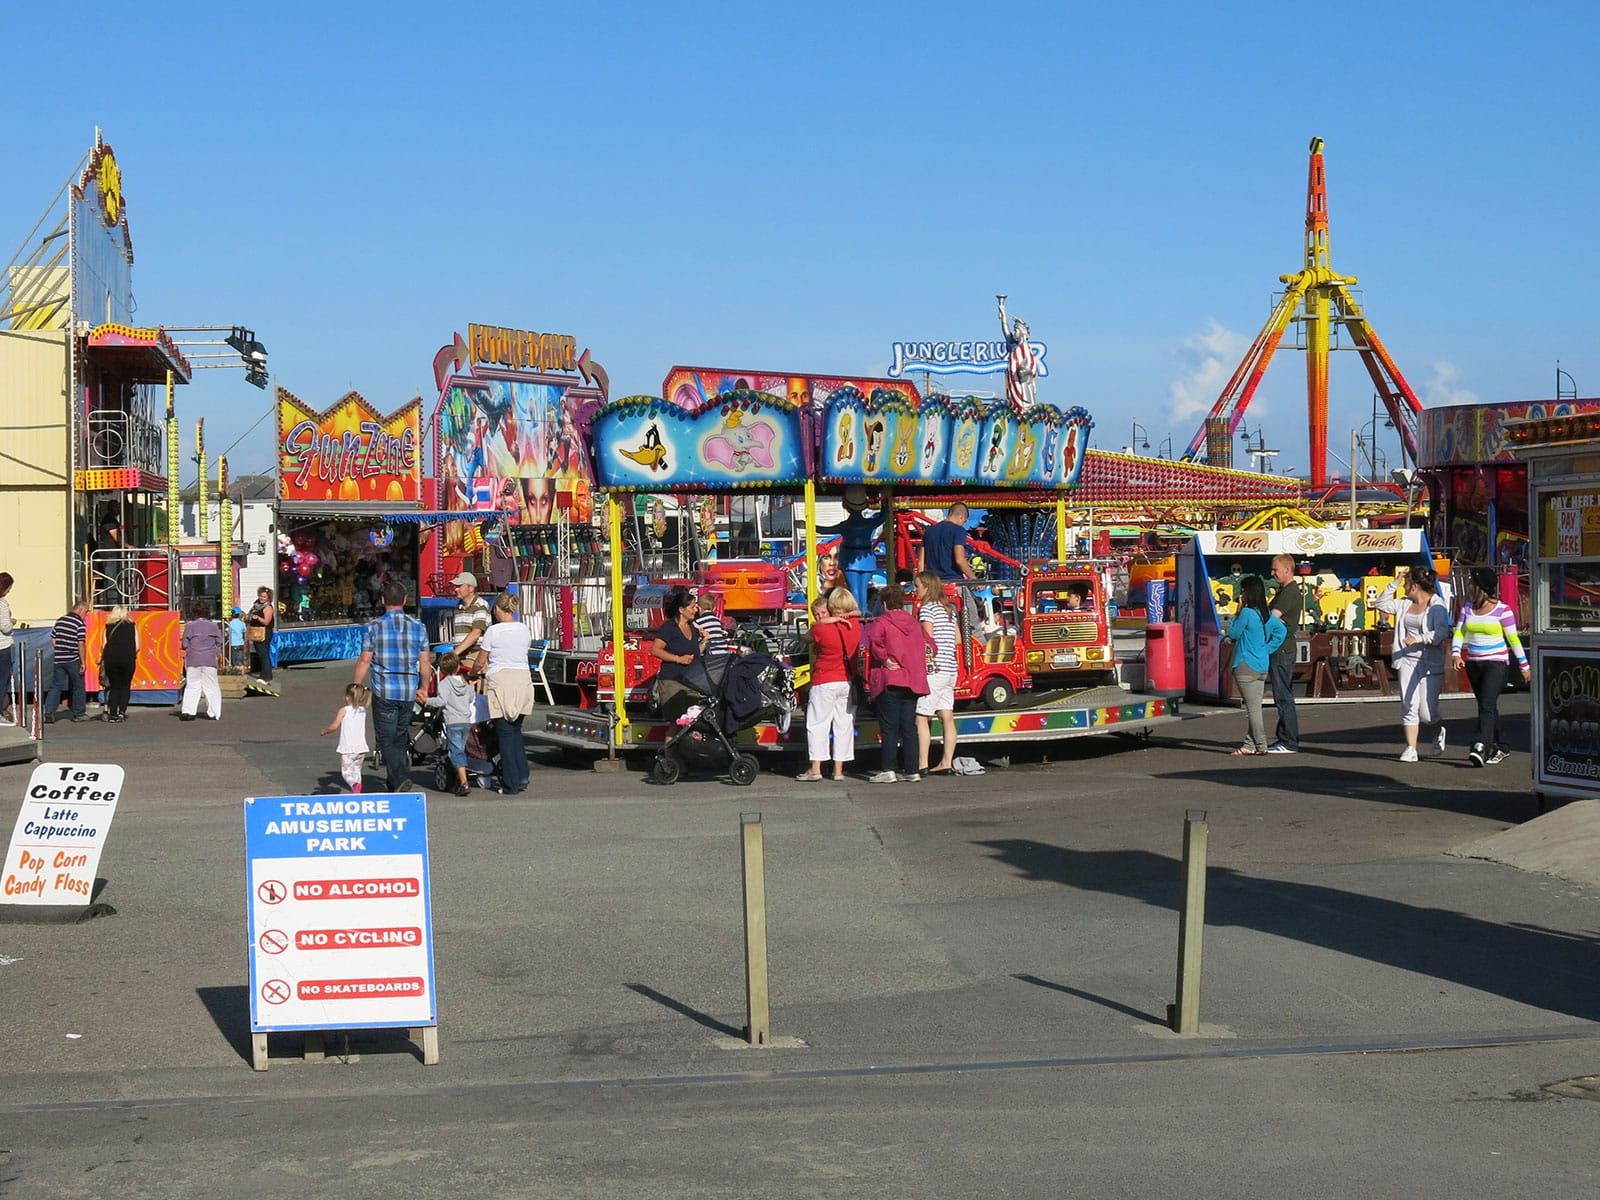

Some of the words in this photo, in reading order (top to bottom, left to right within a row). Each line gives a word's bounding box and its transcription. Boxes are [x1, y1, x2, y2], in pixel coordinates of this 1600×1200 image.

[888, 341, 971, 378] JUNGLE
[974, 341, 1049, 377] RIVR
[286, 420, 360, 486] Fun
[360, 421, 414, 478] Zone
[1550, 496, 1568, 510] PAY
[1571, 494, 1595, 508] HERE
[1561, 511, 1576, 529] PAY
[1221, 534, 1263, 549] Pirate
[1558, 534, 1579, 553] HERE
[59, 767, 100, 782] Tea
[30, 785, 116, 801] Coffee
[44, 807, 79, 821] Latte
[280, 800, 391, 816] TRAMORE
[24, 821, 97, 839] Cappuccino
[265, 817, 407, 835] AMUSEMENT
[306, 837, 367, 851] PARK
[19, 850, 45, 873] Pop
[53, 851, 87, 868] Corn
[5, 874, 47, 897] Candy
[54, 873, 90, 896] Floss
[296, 885, 323, 896] NO
[329, 882, 417, 896] ALCOHOL
[301, 933, 328, 945] NO
[334, 930, 417, 945] CYCLING
[301, 985, 320, 994] NO
[324, 982, 420, 993] SKATEBOARDS
